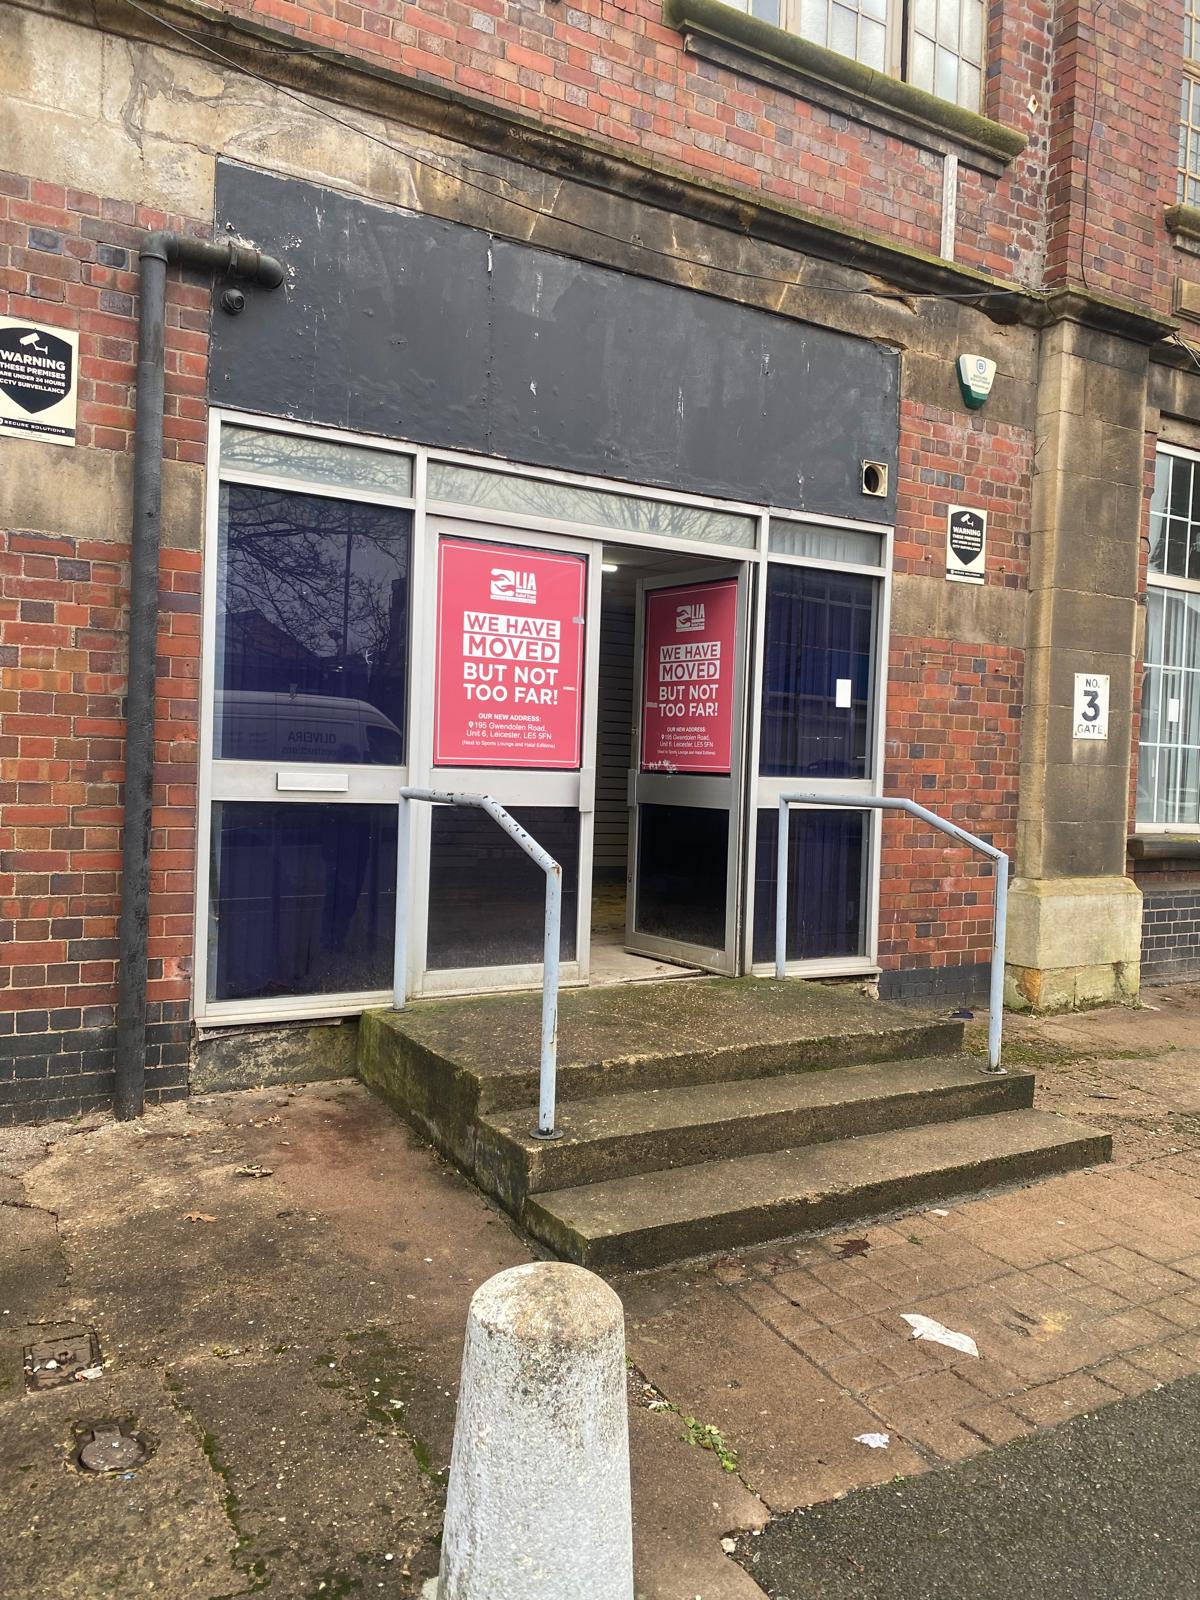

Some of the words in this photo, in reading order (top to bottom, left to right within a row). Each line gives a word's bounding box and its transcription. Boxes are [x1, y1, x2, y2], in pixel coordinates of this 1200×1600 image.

[0, 350, 66, 371] WARNING
[0, 361, 26, 373] THESE
[27, 367, 66, 380] PREMISES
[13, 373, 35, 382] UNDER
[44, 379, 66, 387] HOURS
[17, 381, 65, 395] SURVEILLANCE
[4, 420, 29, 428] SECURE
[30, 424, 66, 434] SOLUTIONS
[953, 526, 981, 537] WARNING
[516, 571, 536, 590] LIA
[690, 604, 705, 619] LIA
[467, 614, 499, 632] WE
[506, 618, 556, 638] HAVE
[469, 635, 556, 661] MOVED
[662, 647, 681, 660] WE
[685, 644, 718, 659] HAVE
[463, 662, 507, 682] BUT
[514, 666, 558, 686] NOT
[662, 662, 717, 680] MOVED
[1085, 678, 1100, 688] NO.
[463, 683, 508, 702] TOO
[514, 687, 558, 705] FAR!
[660, 685, 685, 700] BUT
[689, 684, 719, 700] NOT
[659, 703, 685, 717] TOO
[689, 702, 718, 716] FAR!
[1082, 690, 1100, 722] 3
[478, 712, 492, 720] OUR
[494, 713, 509, 721] NEW
[489, 722, 526, 731] Gwendolen
[1077, 724, 1103, 734] GATE
